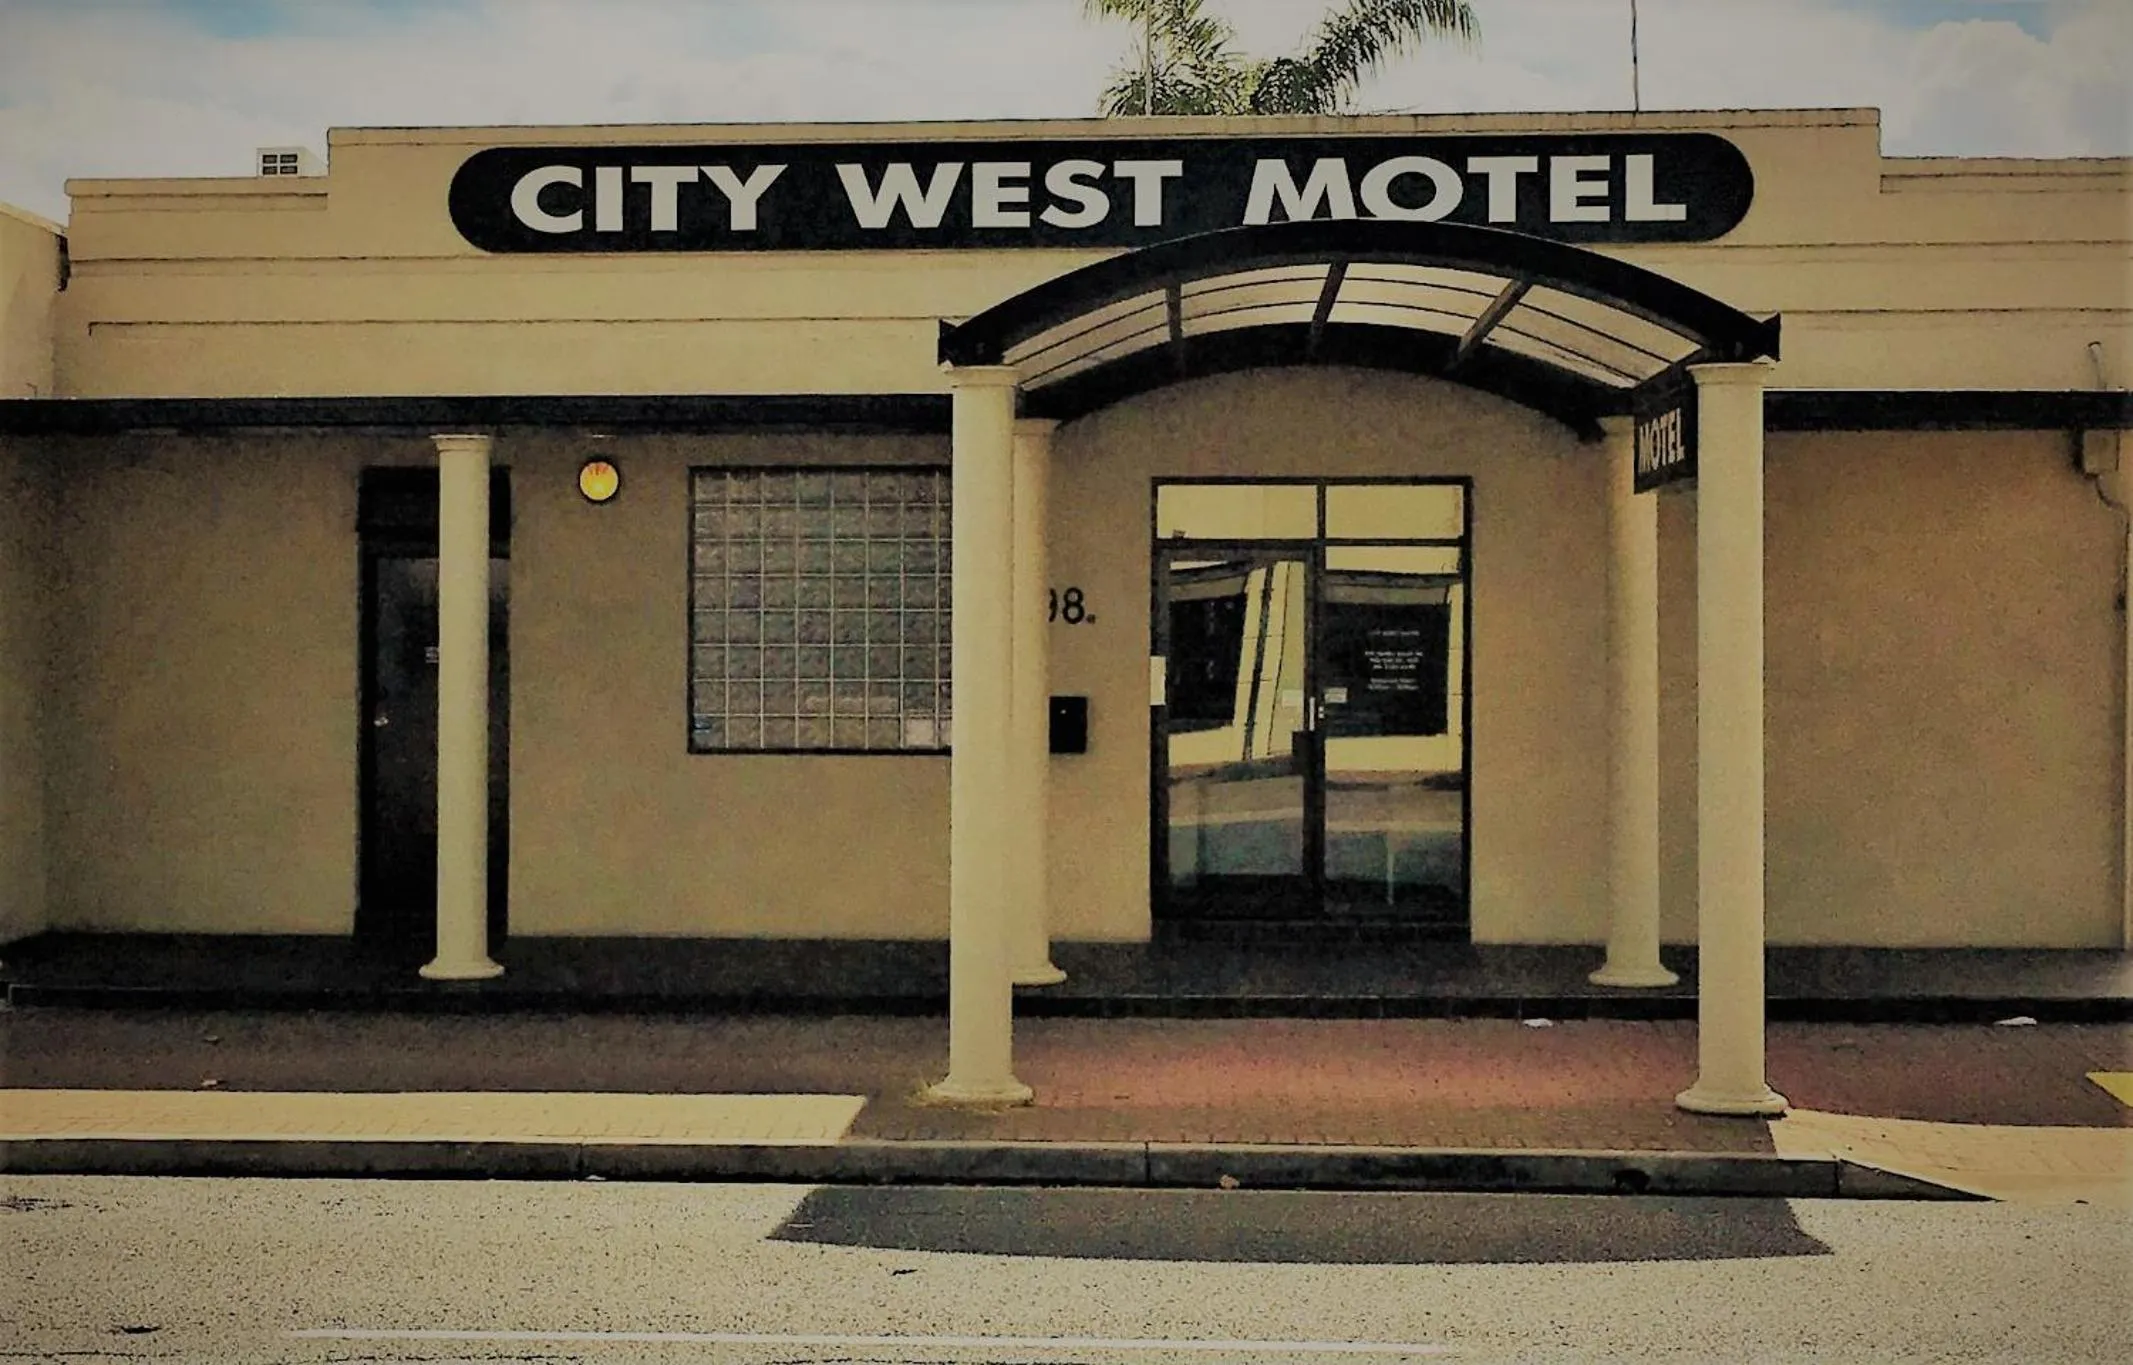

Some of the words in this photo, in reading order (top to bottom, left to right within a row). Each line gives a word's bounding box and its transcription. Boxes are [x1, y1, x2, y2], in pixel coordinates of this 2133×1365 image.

[510, 165, 788, 233] CITY
[836, 160, 1183, 229] WEST
[1242, 155, 1687, 225] MOTEL
[1638, 408, 1685, 474] MOTEL
